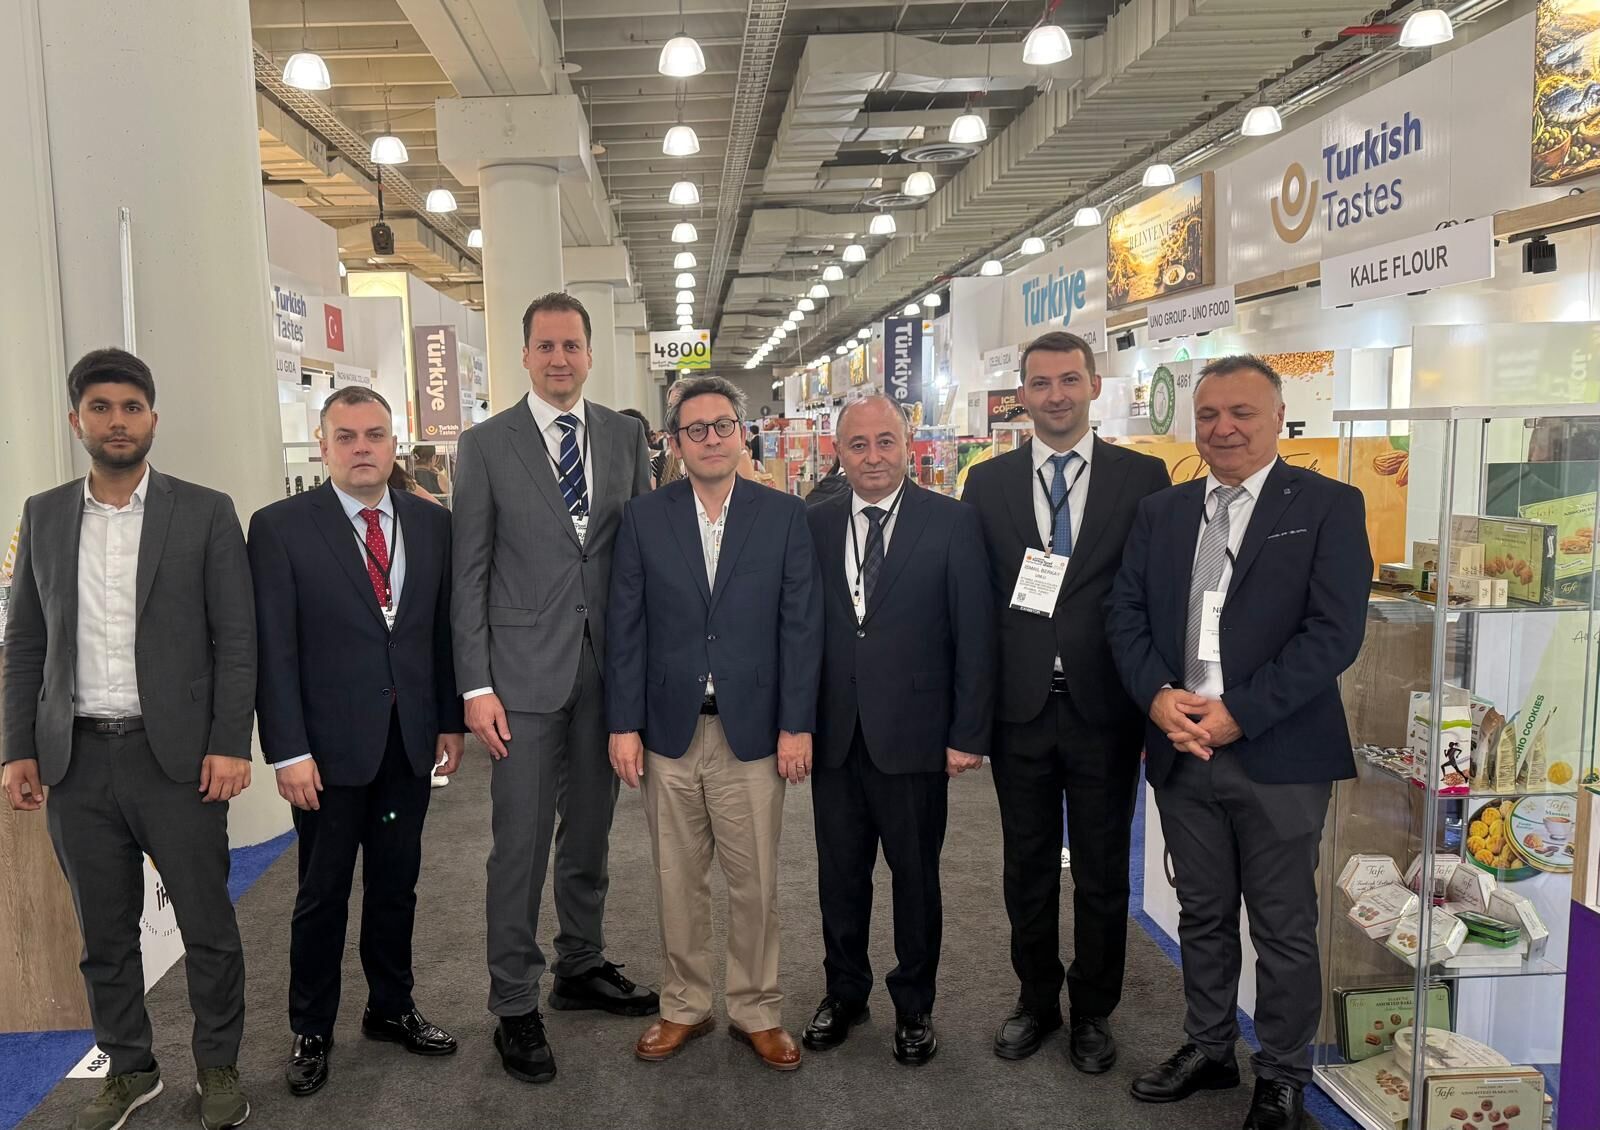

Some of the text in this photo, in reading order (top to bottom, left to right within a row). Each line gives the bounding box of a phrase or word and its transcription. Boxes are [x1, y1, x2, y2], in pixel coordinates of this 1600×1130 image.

[1322, 111, 1422, 183] Turkish
[1322, 178, 1402, 231] Tastes
[1350, 245, 1448, 288] KALE FLOUR
[274, 285, 307, 317] Turkish
[1023, 265, 1086, 327] Türkiye
[275, 313, 304, 343] Tastes
[1150, 314, 1163, 328] UNO
[1164, 309, 1187, 325] GROUP
[1192, 304, 1207, 320] UNO
[1209, 300, 1230, 317] FOOD
[654, 341, 707, 358] 4800
[890, 322, 913, 400] Türkiye
[426, 329, 448, 411] Türkiye
[1001, 395, 1016, 405] ICE
[438, 424, 459, 432] Turkish
[1523, 694, 1545, 736] COOKIES
[1366, 865, 1386, 877] Tafe
[1434, 1086, 1456, 1100] Tafe
